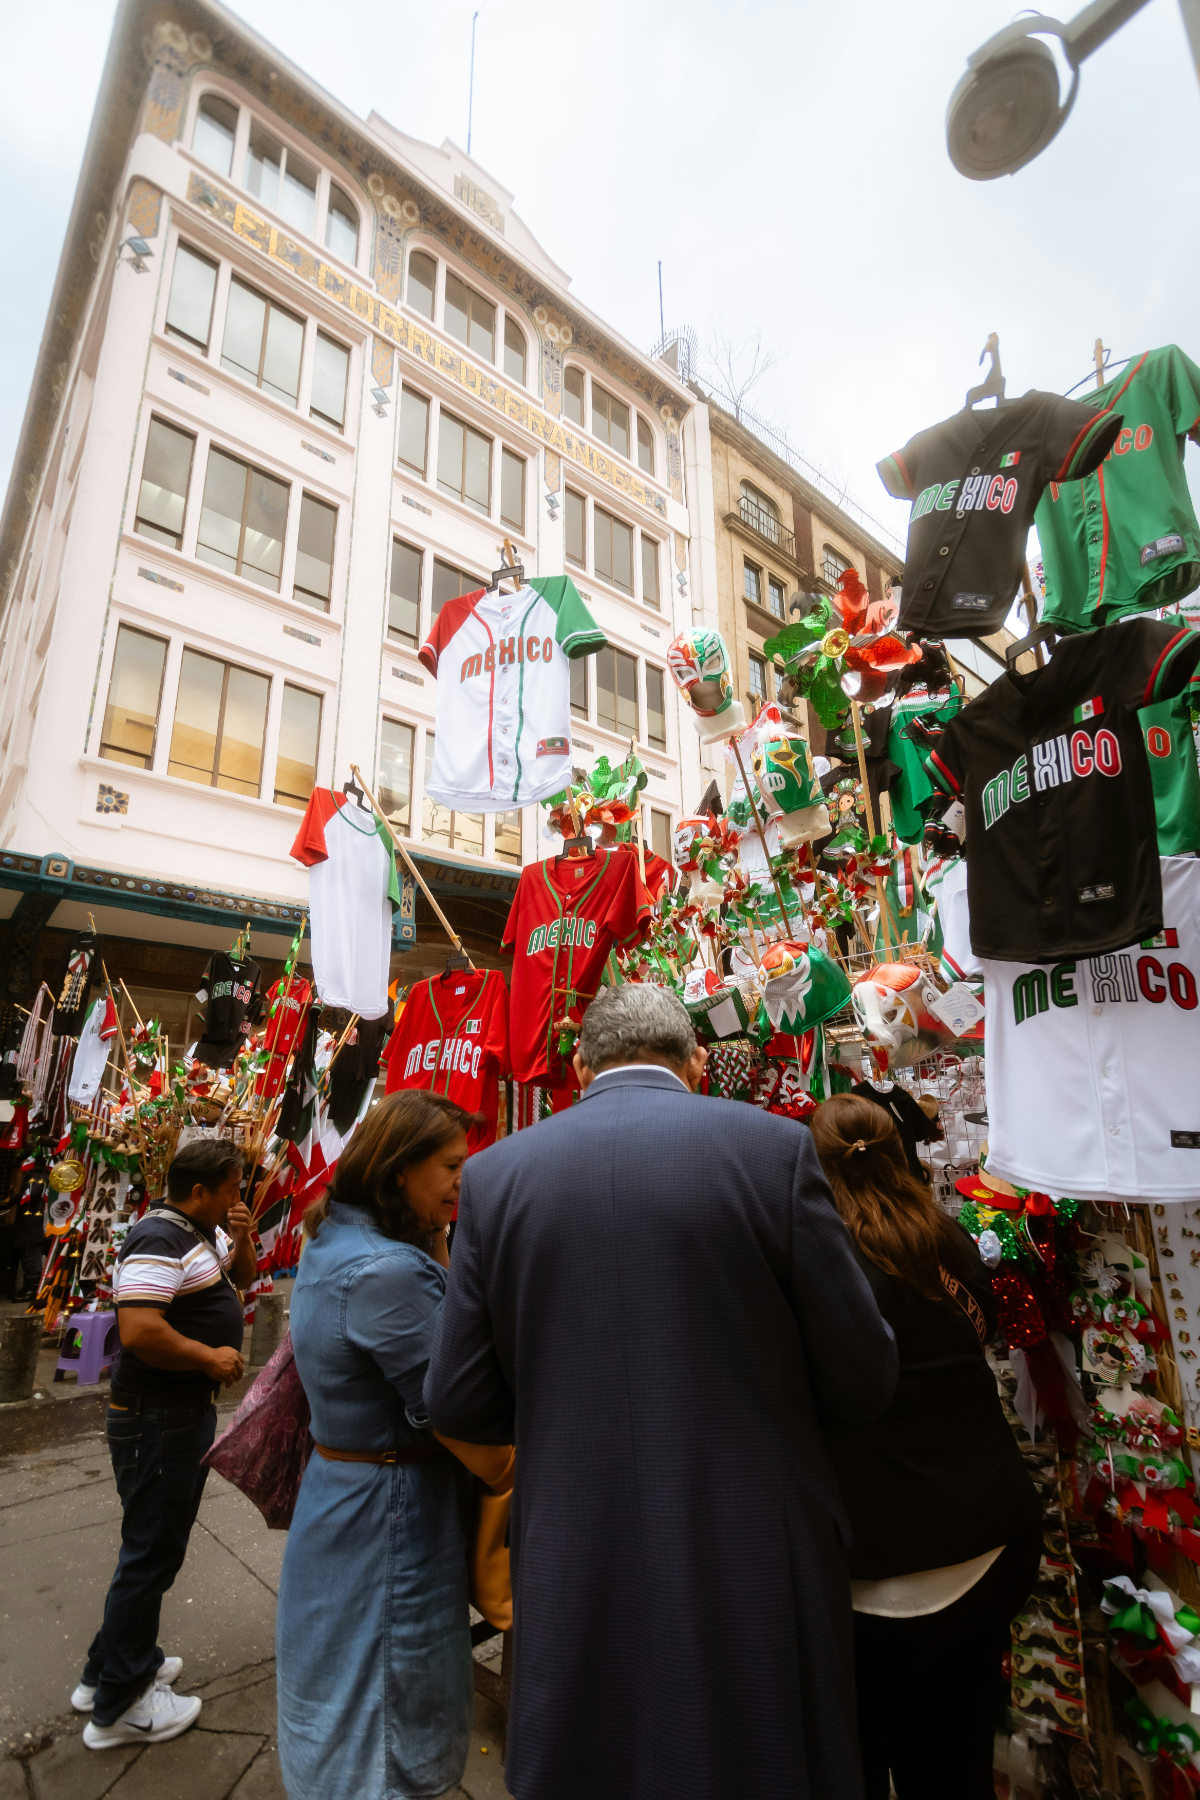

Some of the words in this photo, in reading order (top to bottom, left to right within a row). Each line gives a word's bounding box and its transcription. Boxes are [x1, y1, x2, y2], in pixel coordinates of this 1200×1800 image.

[233, 203, 296, 273] EL
[317, 262, 483, 397] CORREO
[504, 387, 648, 506] FRANCES
[909, 474, 1018, 525] MEXICO
[460, 635, 553, 683] MEXICO
[981, 728, 1122, 831] MEXICO
[526, 917, 600, 957] MEXIC
[1012, 953, 1198, 1026] MEXICO
[403, 1038, 482, 1081] MEXICO
